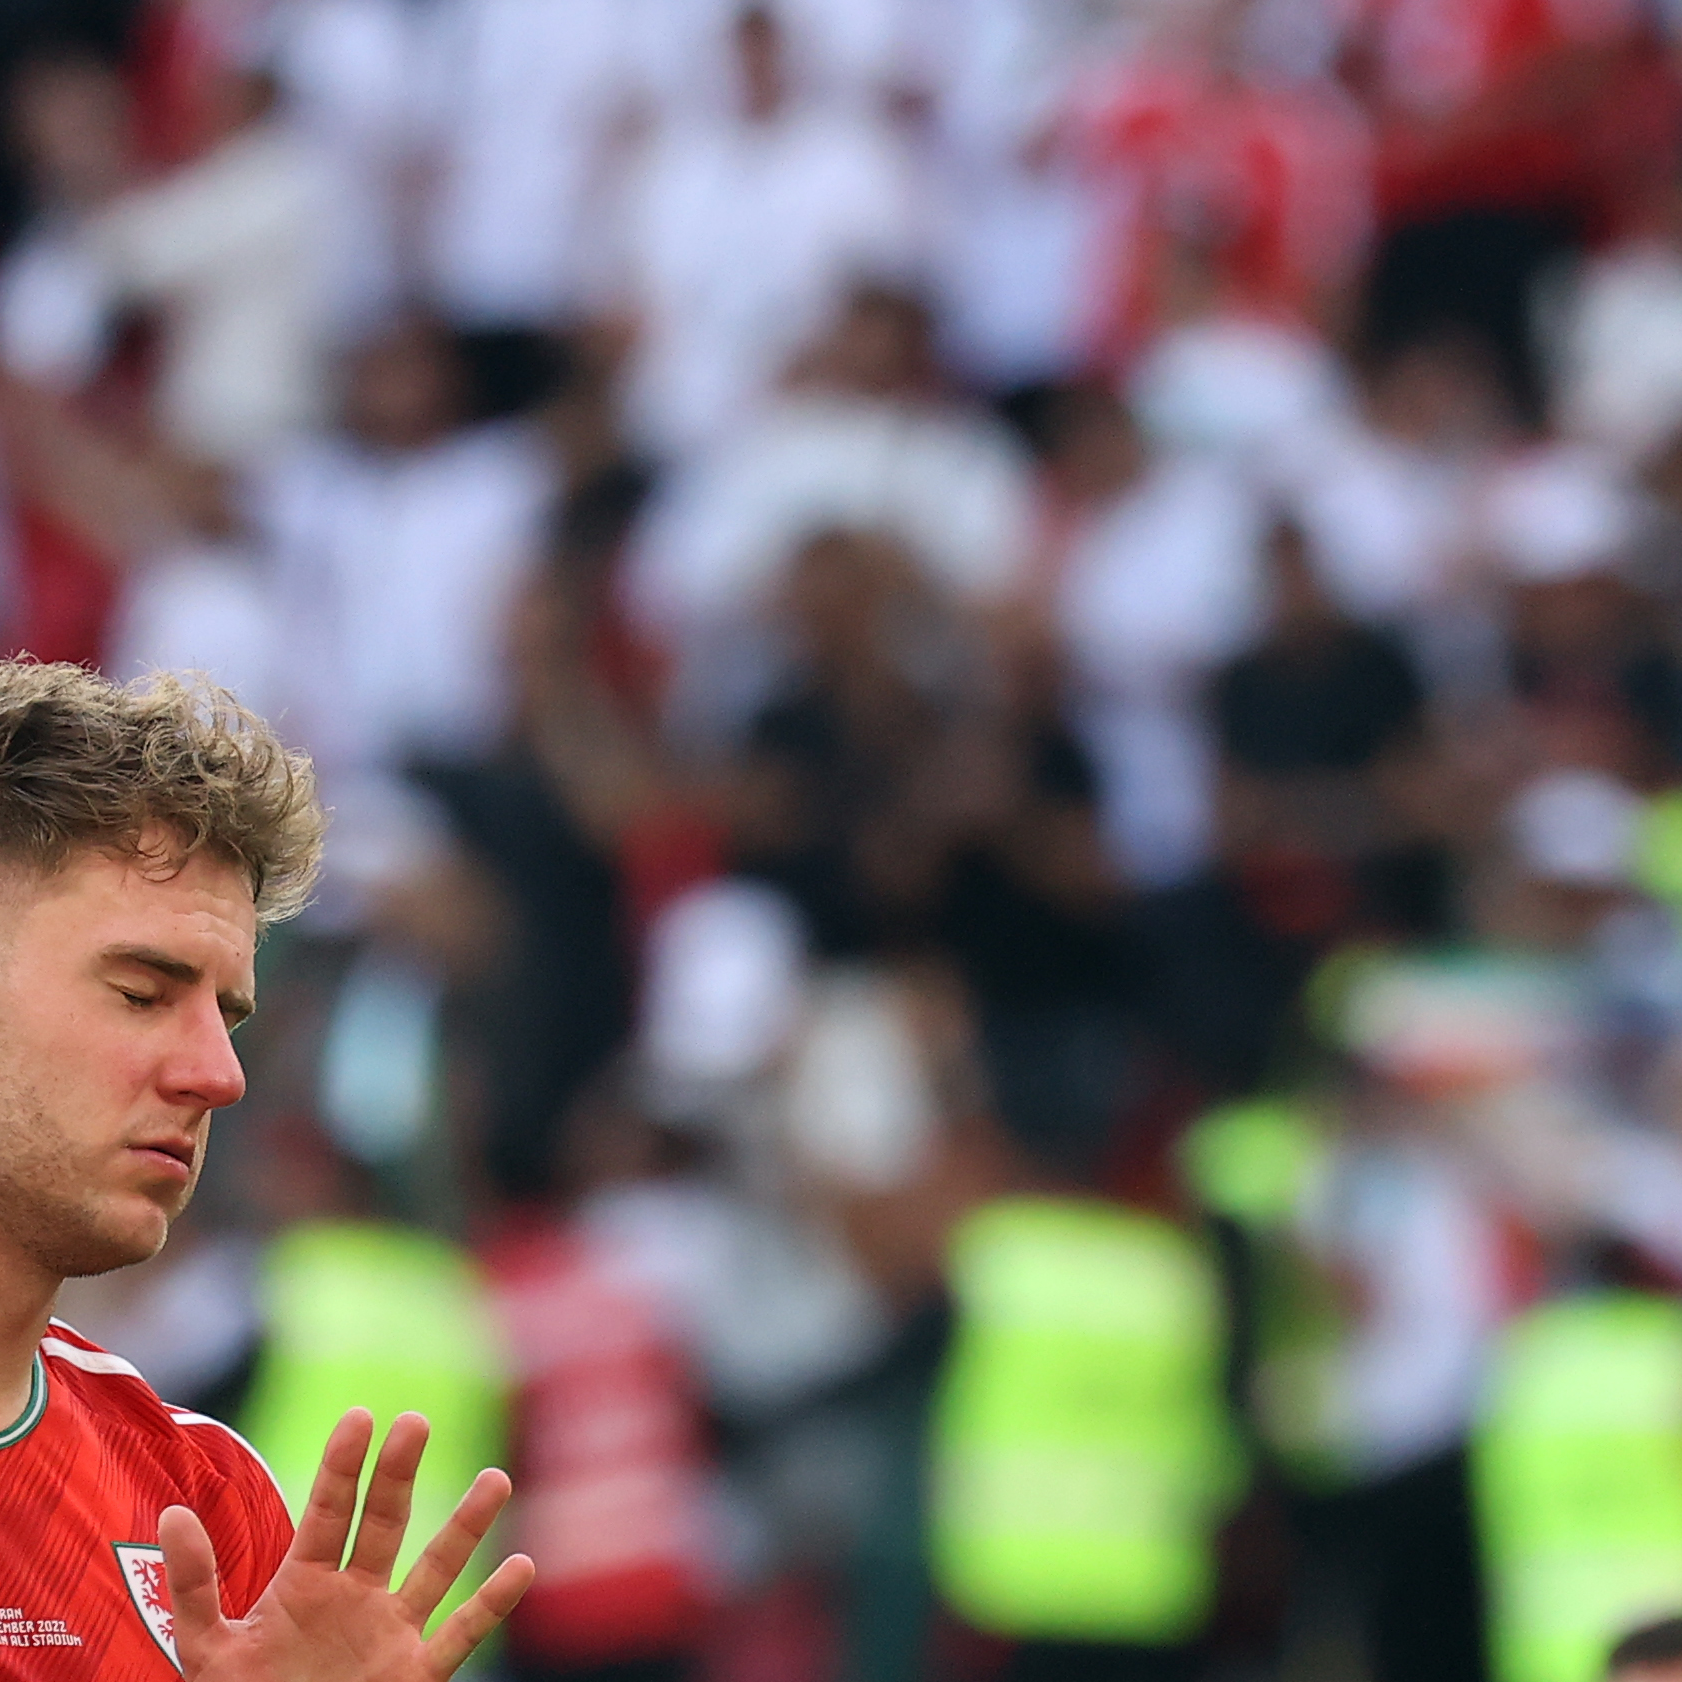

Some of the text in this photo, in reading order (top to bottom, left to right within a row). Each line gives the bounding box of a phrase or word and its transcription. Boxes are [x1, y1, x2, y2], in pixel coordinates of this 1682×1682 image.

[36, 1620, 67, 1633] 2022
[9, 1634, 30, 1647] ALI
[32, 1634, 83, 1647] STADIUM
